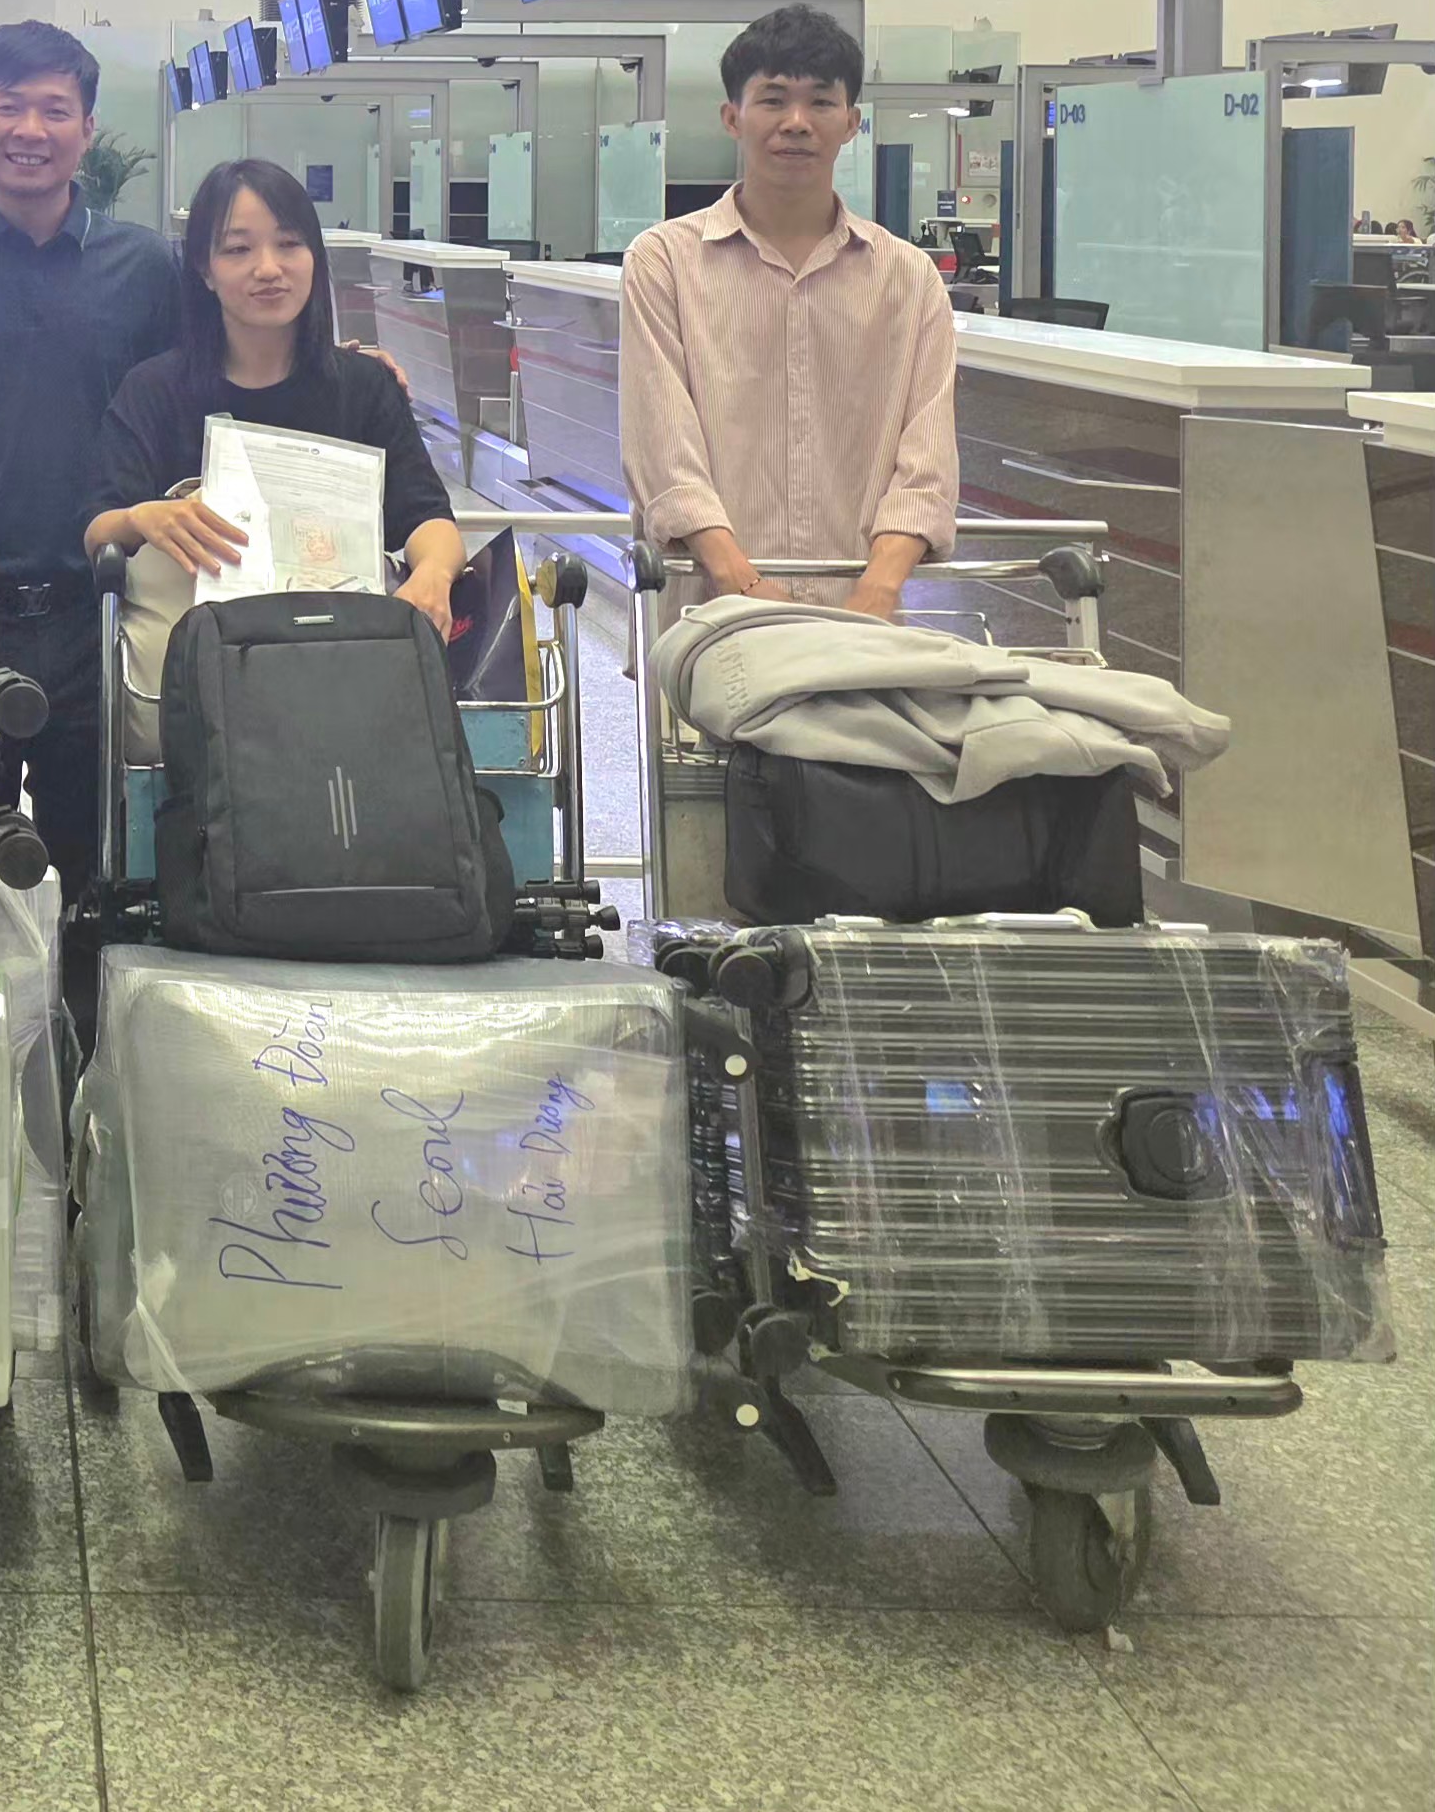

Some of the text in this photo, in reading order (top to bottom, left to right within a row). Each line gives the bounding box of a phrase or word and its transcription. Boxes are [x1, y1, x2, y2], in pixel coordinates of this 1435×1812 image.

[1060, 103, 1086, 124] D-03
[1224, 93, 1259, 117] D-02
[371, 1087, 468, 1262] Seoul
